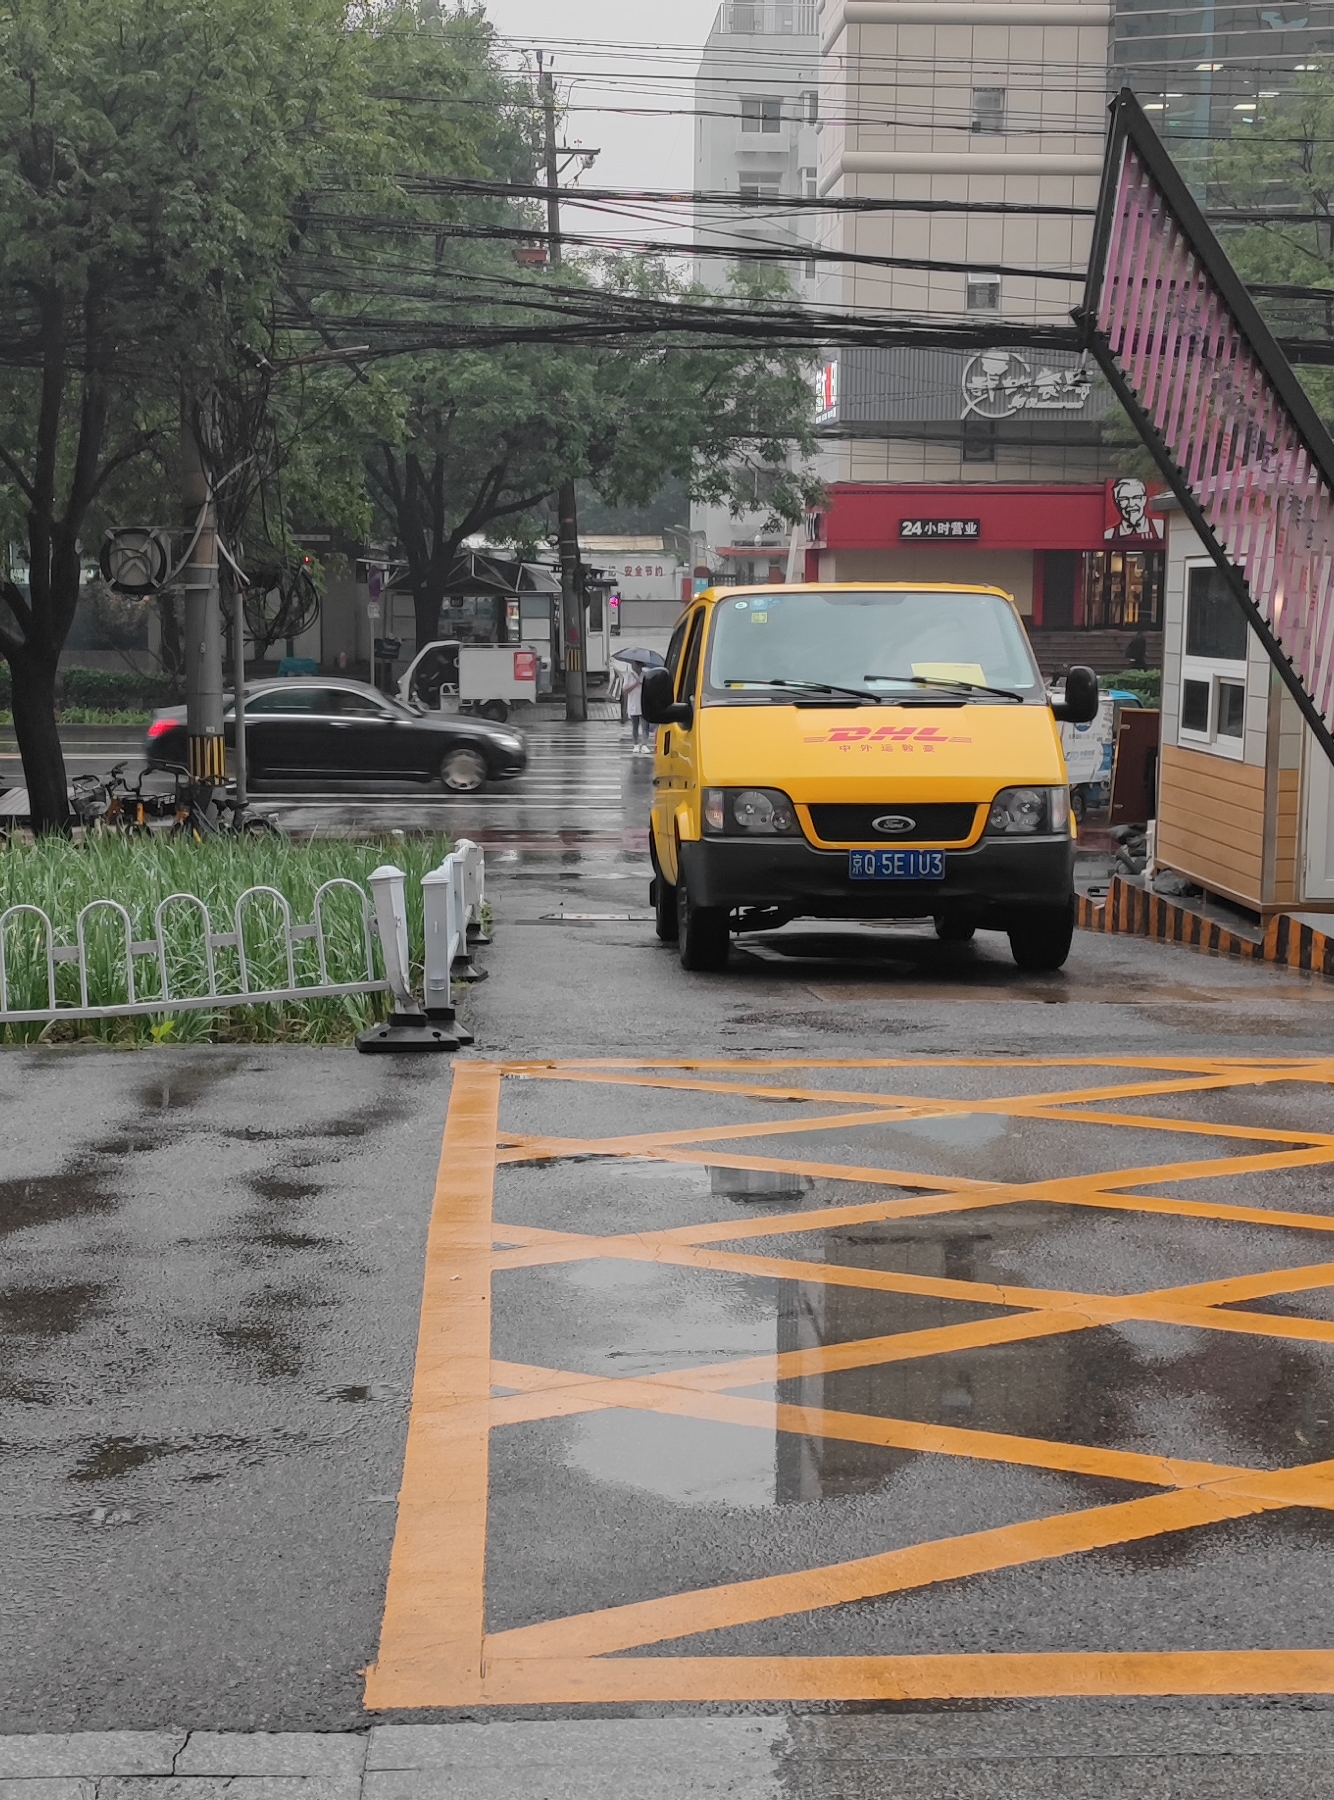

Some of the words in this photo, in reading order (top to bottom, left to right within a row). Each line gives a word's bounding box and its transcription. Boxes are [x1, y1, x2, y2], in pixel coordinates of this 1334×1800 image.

[901, 521, 978, 536] 24小时营业
[624, 565, 663, 578] 安全节约
[826, 726, 949, 742] DHL
